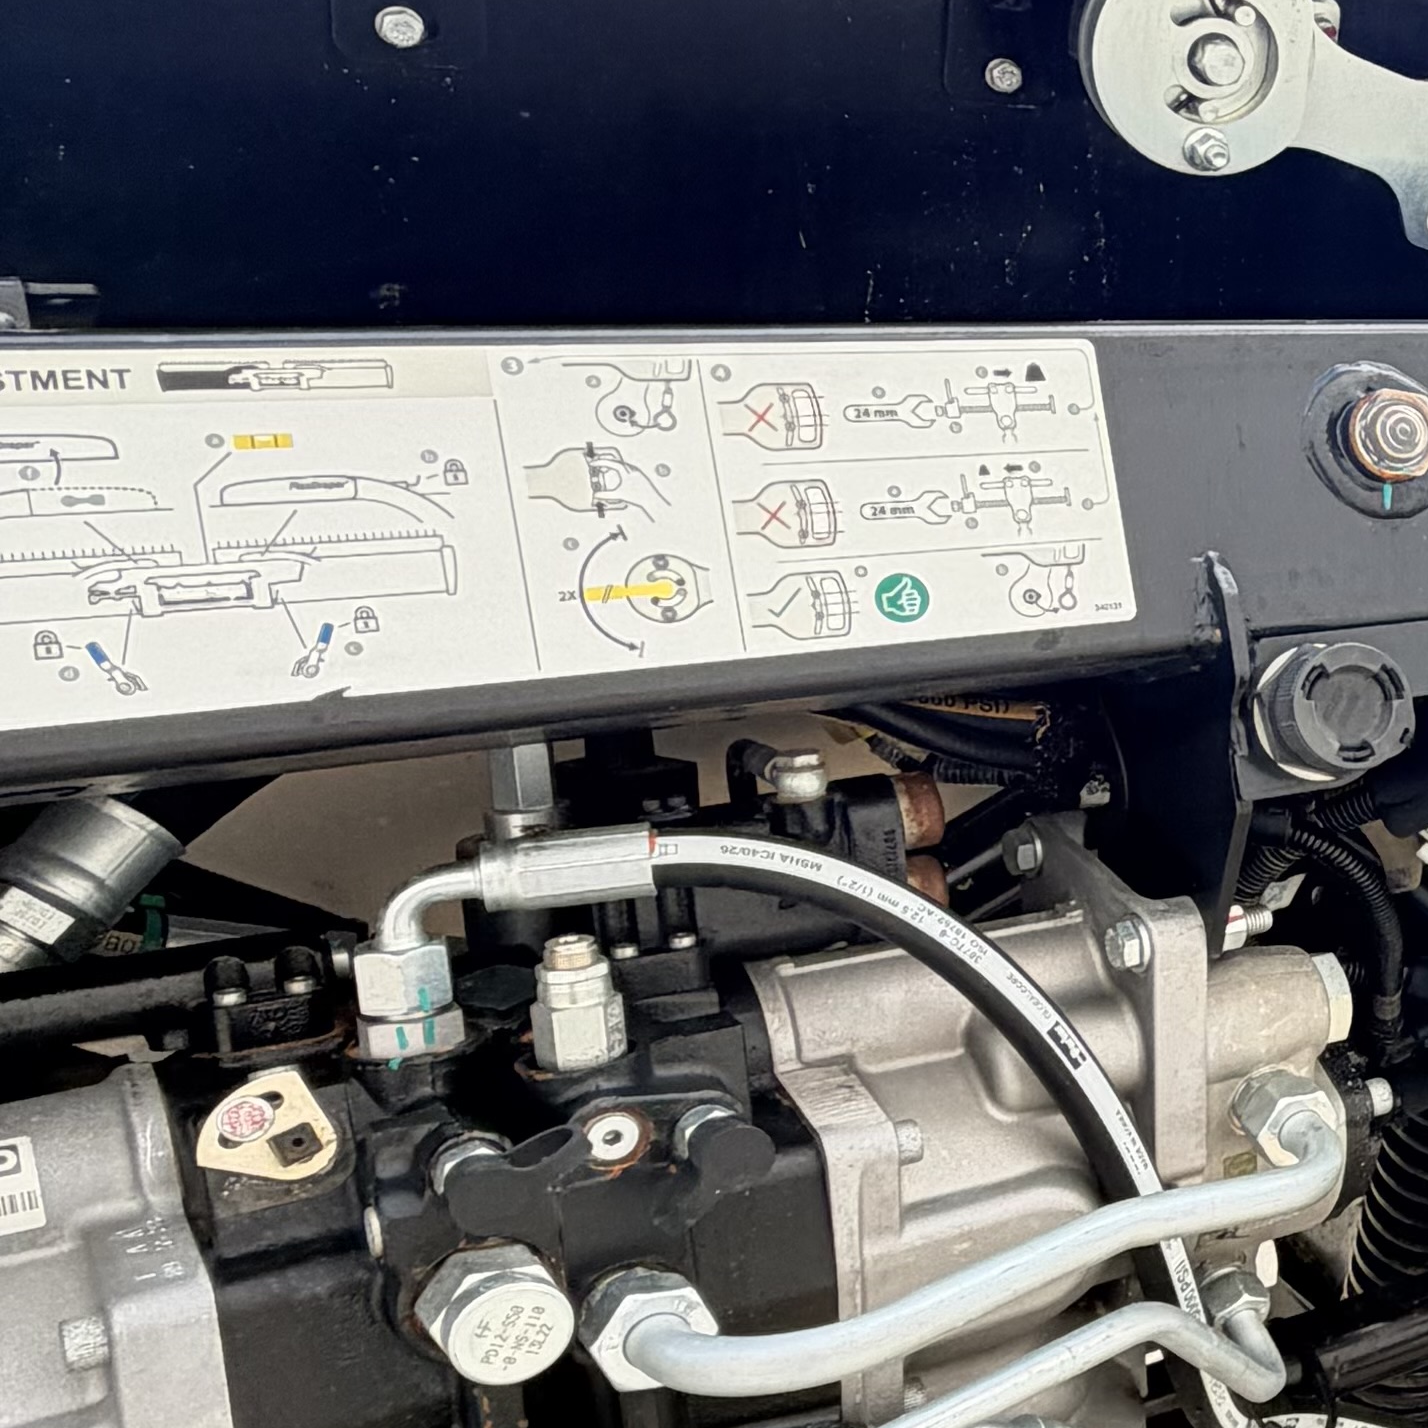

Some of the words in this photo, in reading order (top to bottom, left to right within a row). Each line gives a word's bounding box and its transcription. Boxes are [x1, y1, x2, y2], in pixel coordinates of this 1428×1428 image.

[853, 407, 870, 419] 24
[873, 408, 898, 418] mm
[870, 505, 887, 517] 24
[890, 506, 915, 516] mm
[558, 590, 577, 602] 2X
[877, 892, 900, 910] mm
